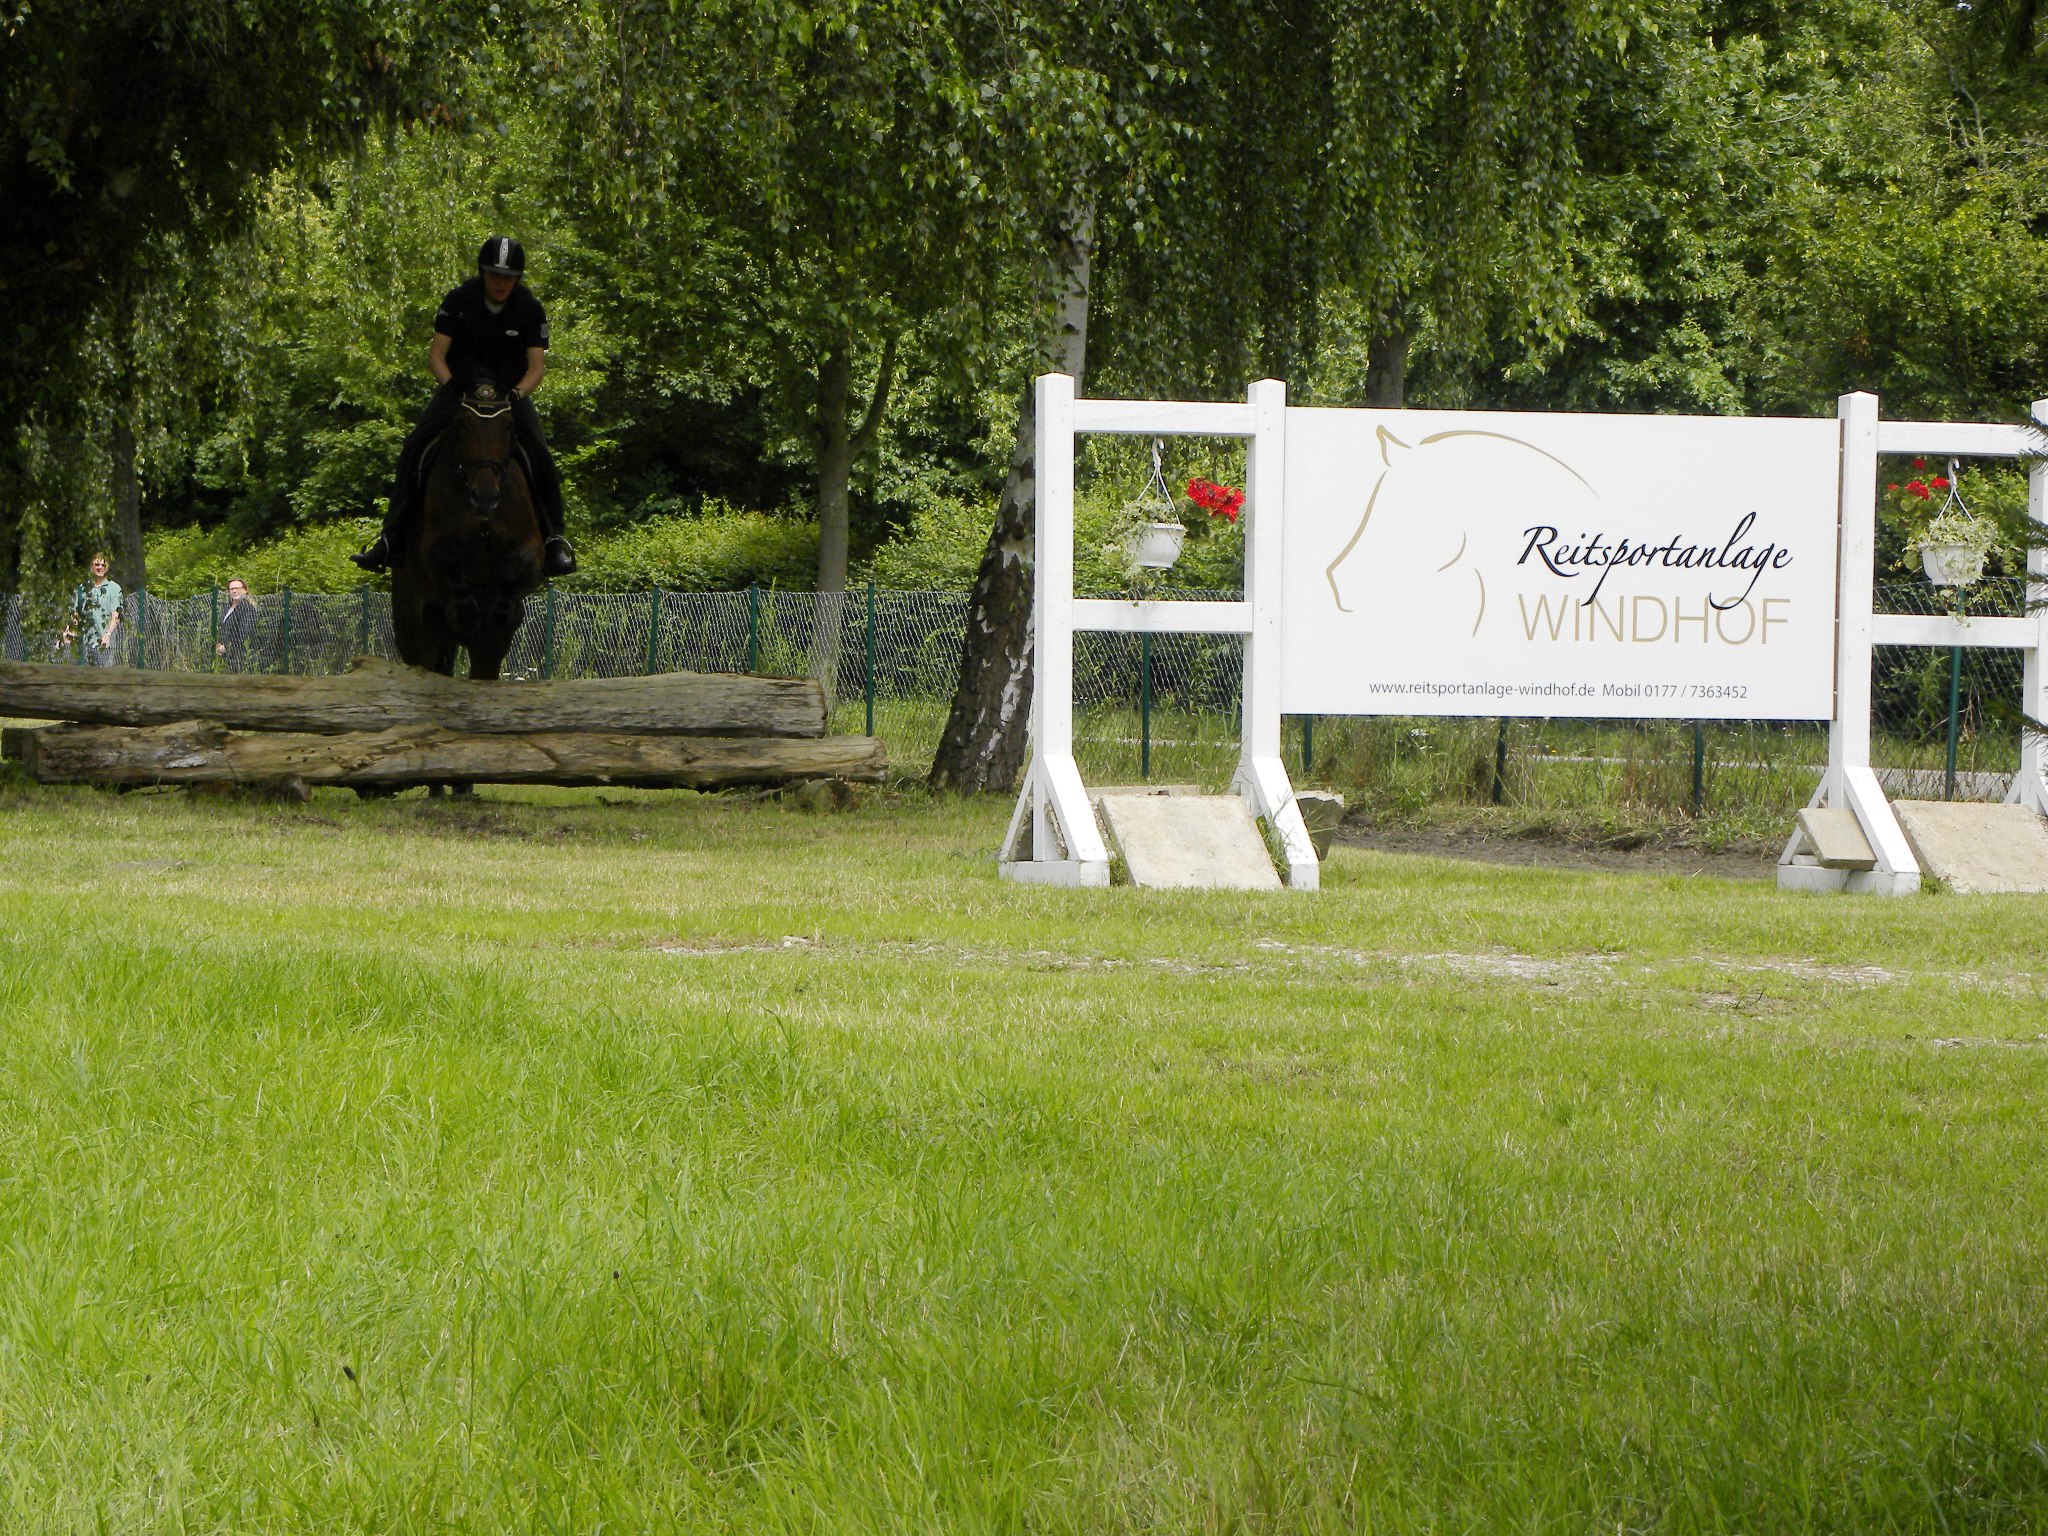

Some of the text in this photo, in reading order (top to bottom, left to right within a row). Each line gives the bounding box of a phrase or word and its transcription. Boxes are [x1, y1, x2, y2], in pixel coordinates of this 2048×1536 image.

[1517, 511, 1793, 610] Reitsportanlage
[1518, 593, 1791, 645] WINDHOF
[1369, 681, 1748, 699] www.reitsportanlage-windhof.de Mobil 0177 / 7363452
